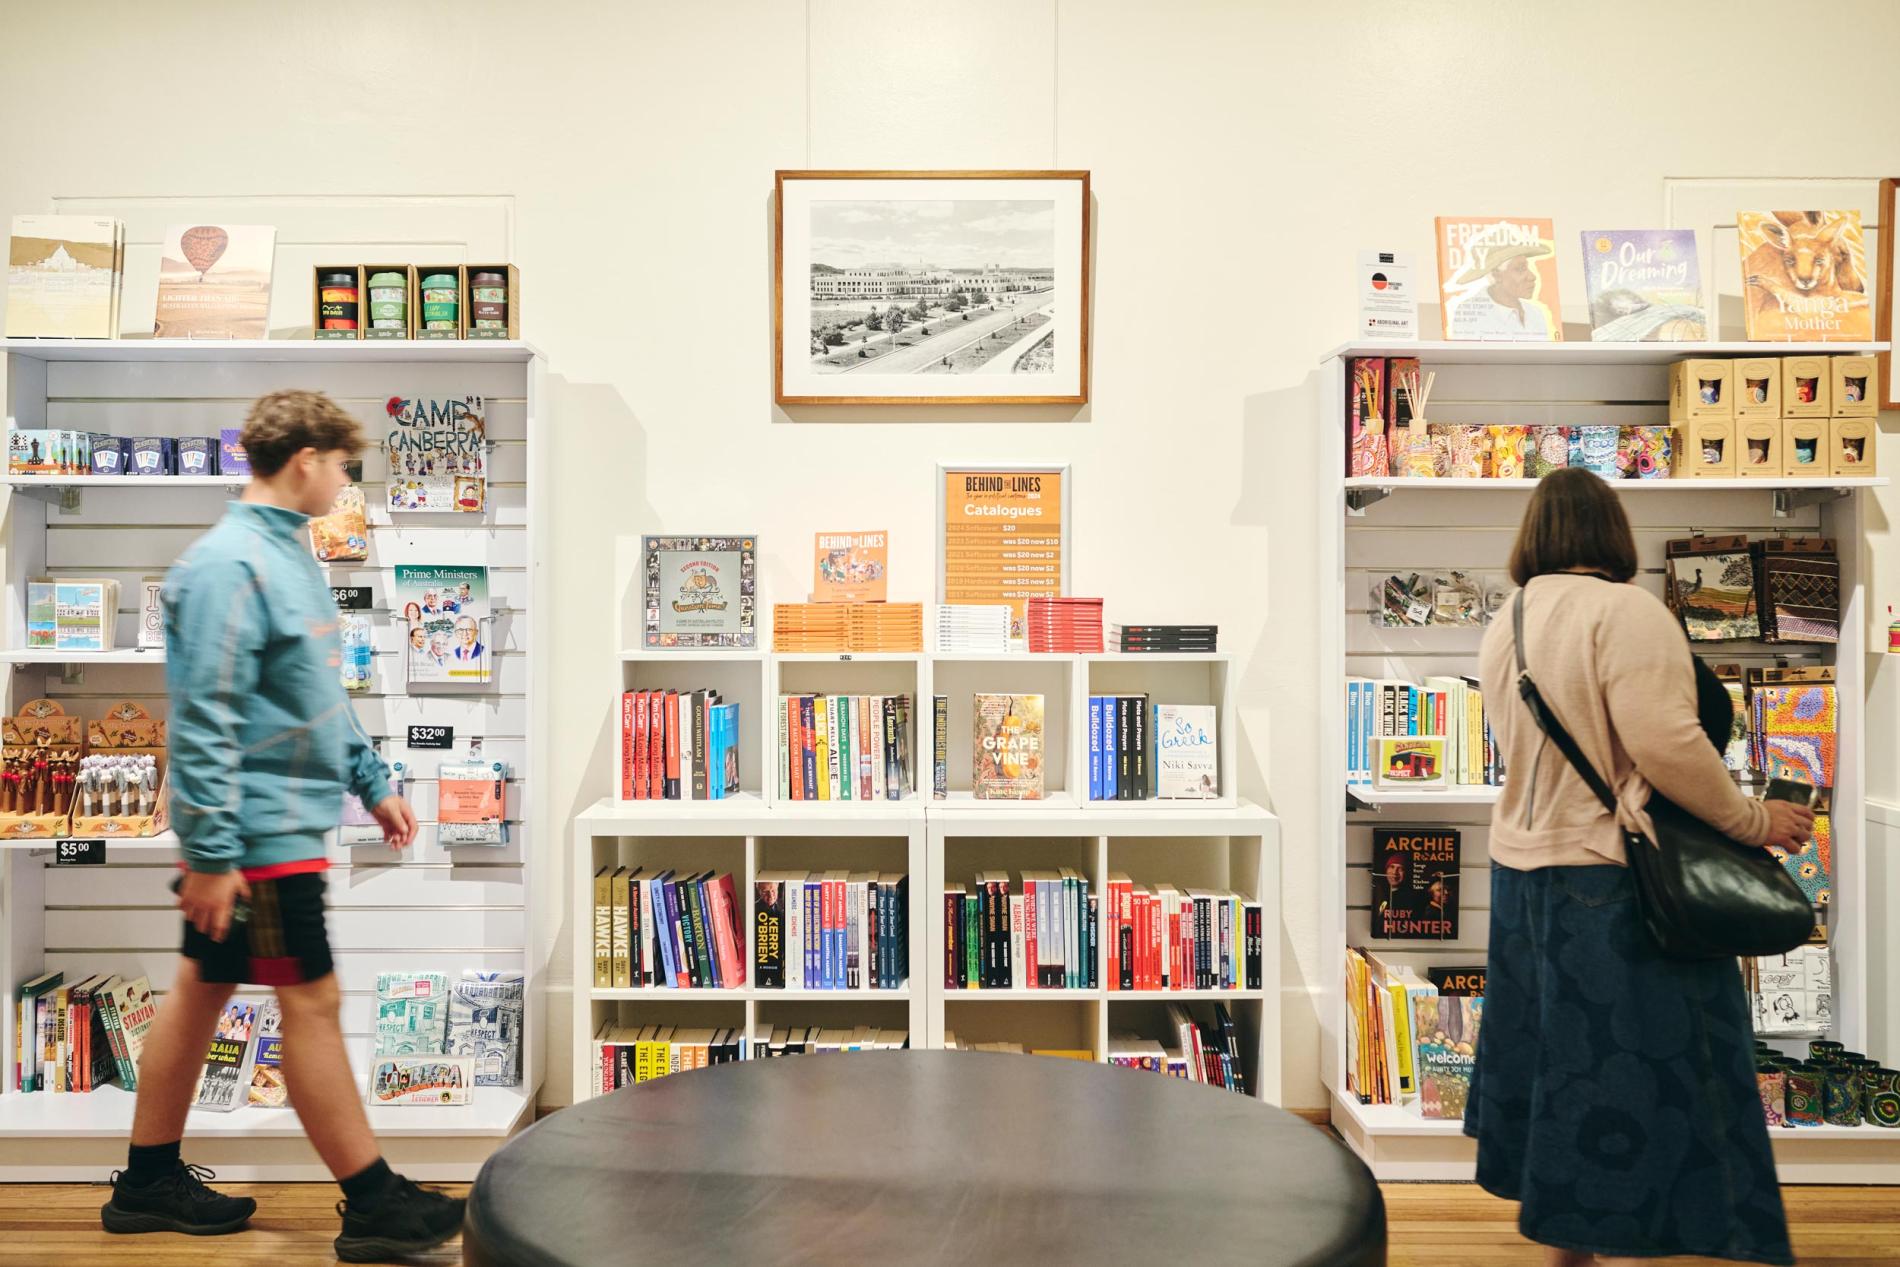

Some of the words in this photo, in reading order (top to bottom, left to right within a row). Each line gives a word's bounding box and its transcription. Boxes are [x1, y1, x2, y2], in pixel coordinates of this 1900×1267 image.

[1619, 241, 1657, 267] Our
[1601, 259, 1688, 290] Dreaming
[1784, 316, 1843, 331] Mother
[394, 399, 471, 432] CAMP
[389, 431, 481, 456] CANBERRA
[966, 476, 1003, 492] BEHIND
[1012, 476, 1041, 492] LINES
[964, 503, 1043, 518] Catalogues
[1002, 524, 1016, 532] $20
[819, 535, 852, 549] BEHIND
[860, 534, 884, 548] LINES
[1017, 551, 1030, 559] $20
[1045, 551, 1054, 559] $2
[402, 569, 432, 579] Prime
[433, 569, 478, 580] Ministers
[624, 698, 632, 713] Kim
[653, 698, 661, 713] Kim
[780, 702, 788, 712] THE
[935, 700, 946, 713] THE
[1384, 691, 1394, 713] BLACK
[1399, 691, 1409, 713] BLACK
[624, 713, 632, 729] Carr
[653, 713, 661, 729] Carr
[780, 712, 788, 732] FOREST
[872, 700, 880, 729] PEOPLE
[411, 726, 435, 740] $32
[1001, 725, 1020, 734] THE
[1091, 705, 1099, 752] Bulldozed
[1106, 704, 1114, 752] Bulldozed
[1175, 717, 1193, 735] So
[780, 732, 788, 748] WARS
[873, 731, 881, 760] POWER
[935, 713, 946, 763] UNDERHISTORY
[983, 736, 1039, 750] GRAPE
[1161, 728, 1213, 748] Greek
[623, 739, 632, 756] Long
[636, 739, 645, 756] Long
[652, 739, 661, 756] Long
[992, 752, 1029, 765] VINE
[1163, 760, 1184, 769] Niki
[1187, 760, 1213, 770] Savva
[624, 756, 632, 779] March
[652, 756, 661, 779] March
[60, 842, 77, 857] $5
[1384, 837, 1455, 851] ARCHIE
[1413, 851, 1454, 862] ROACH
[1013, 903, 1022, 933] ALBANESE
[1384, 909, 1413, 919] RUBY
[596, 905, 611, 959] HAWKE
[613, 905, 628, 959] HAWKE
[682, 914, 692, 943] VICTORY
[693, 909, 705, 950] BARTON
[1383, 921, 1452, 934] HUNTER
[758, 911, 768, 963] O'BRIEN
[768, 917, 778, 959] KERRY
[1442, 975, 1488, 990] ARCH
[57, 1008, 65, 1017] AIR
[123, 1002, 156, 1031] STRAYAN
[57, 1018, 65, 1042] DISASTER
[379, 1023, 404, 1033] RESPECT
[471, 1029, 497, 1039] RESPECT
[639, 1047, 649, 1063] THE
[656, 1047, 666, 1063] THE
[683, 1049, 692, 1071] THE
[1426, 1051, 1476, 1066] welcome
